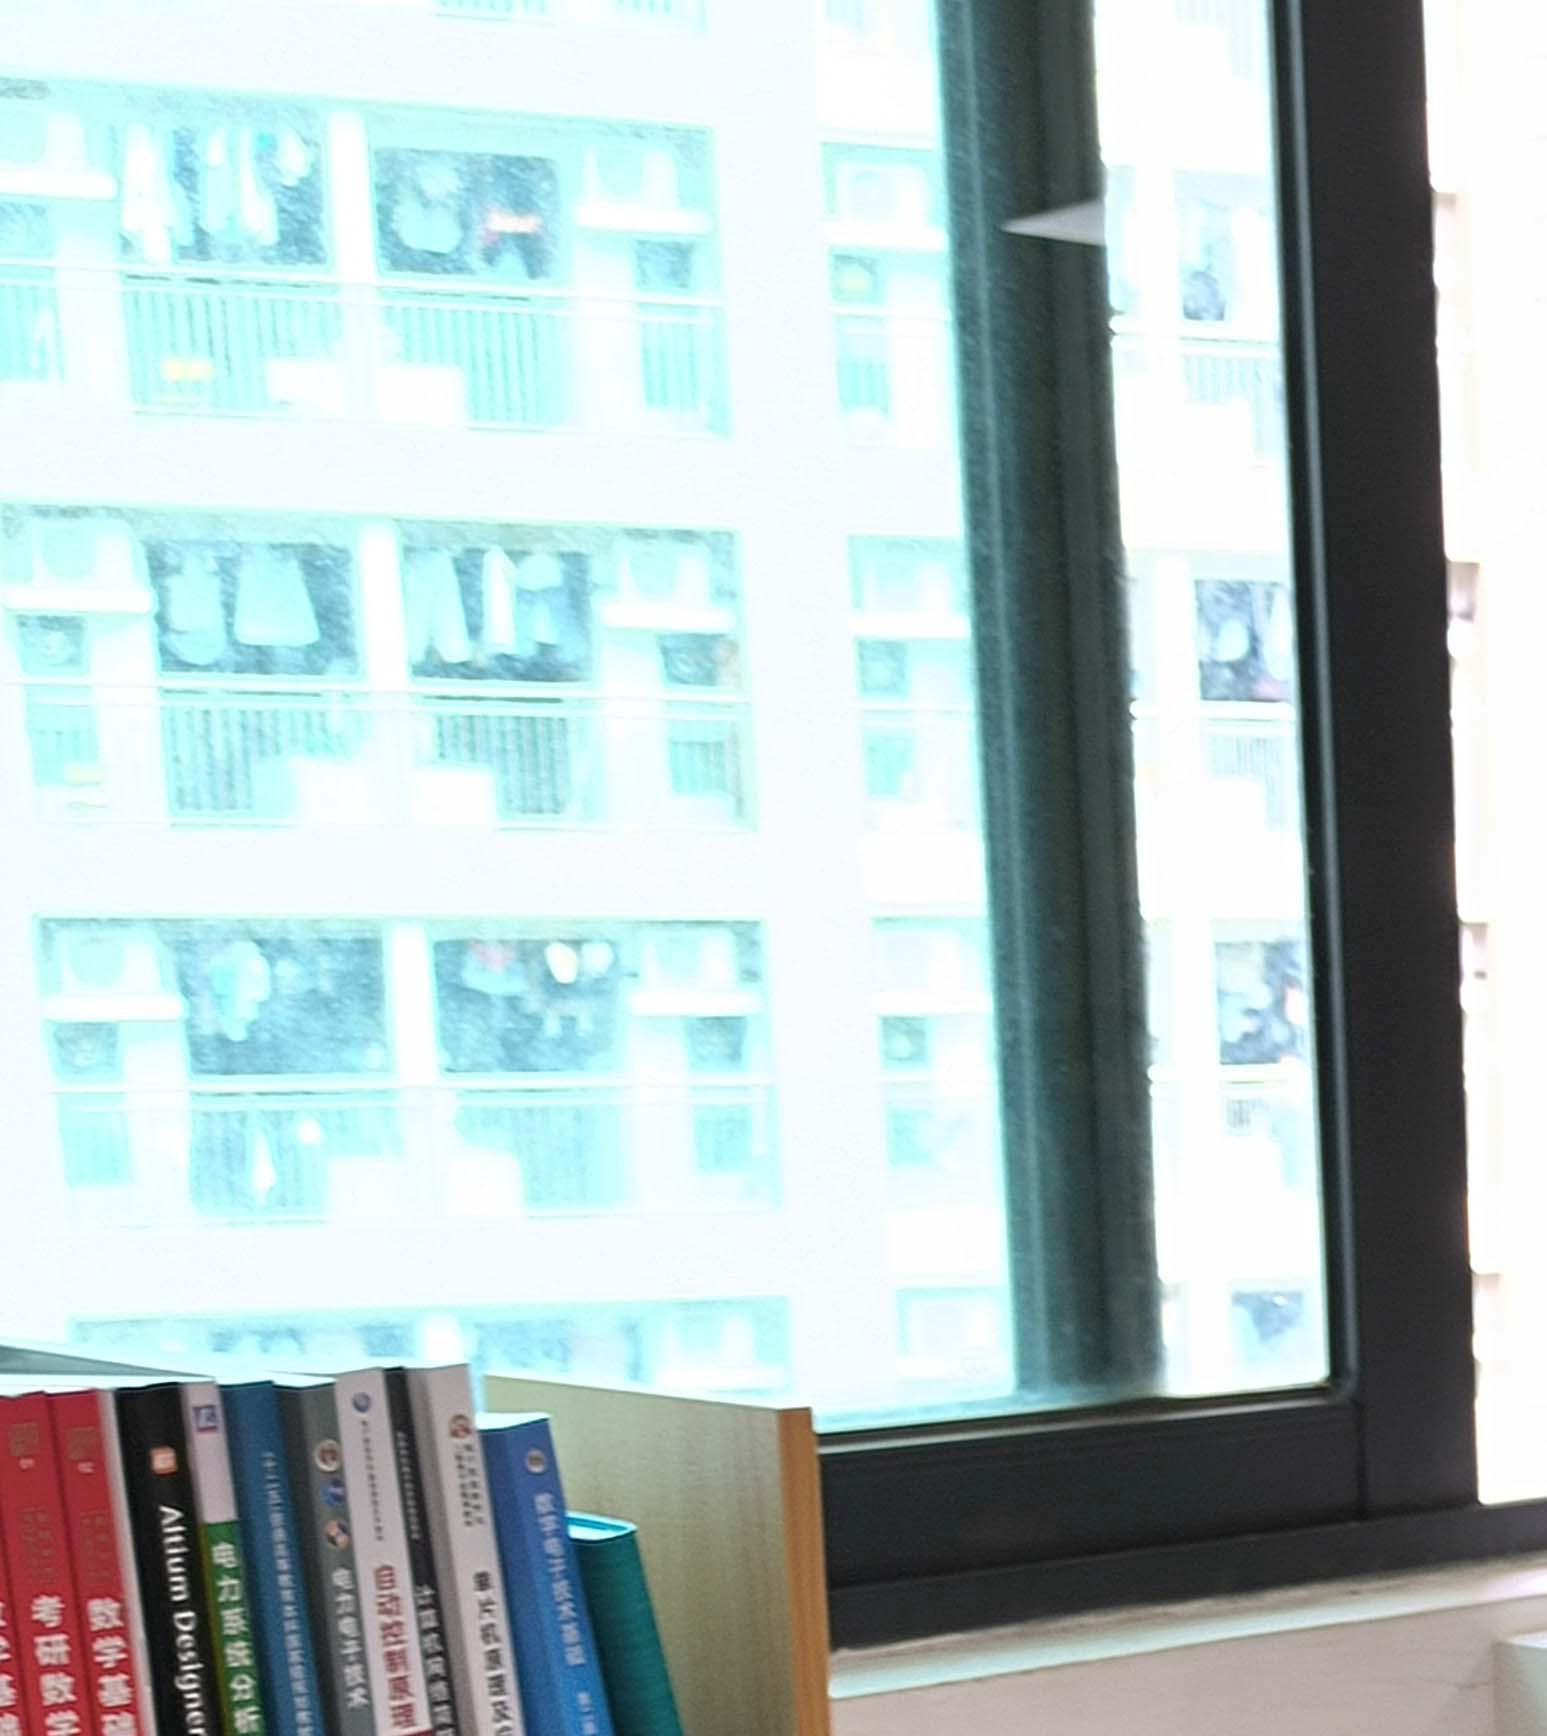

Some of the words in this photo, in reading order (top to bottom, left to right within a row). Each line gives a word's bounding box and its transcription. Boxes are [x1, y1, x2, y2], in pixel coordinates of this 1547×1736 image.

[157, 1503, 189, 1603] Altium
[210, 1541, 260, 1734] 电力系统分析
[331, 1567, 370, 1710] 电力电子技术
[373, 1563, 419, 1730] 自动控制原理
